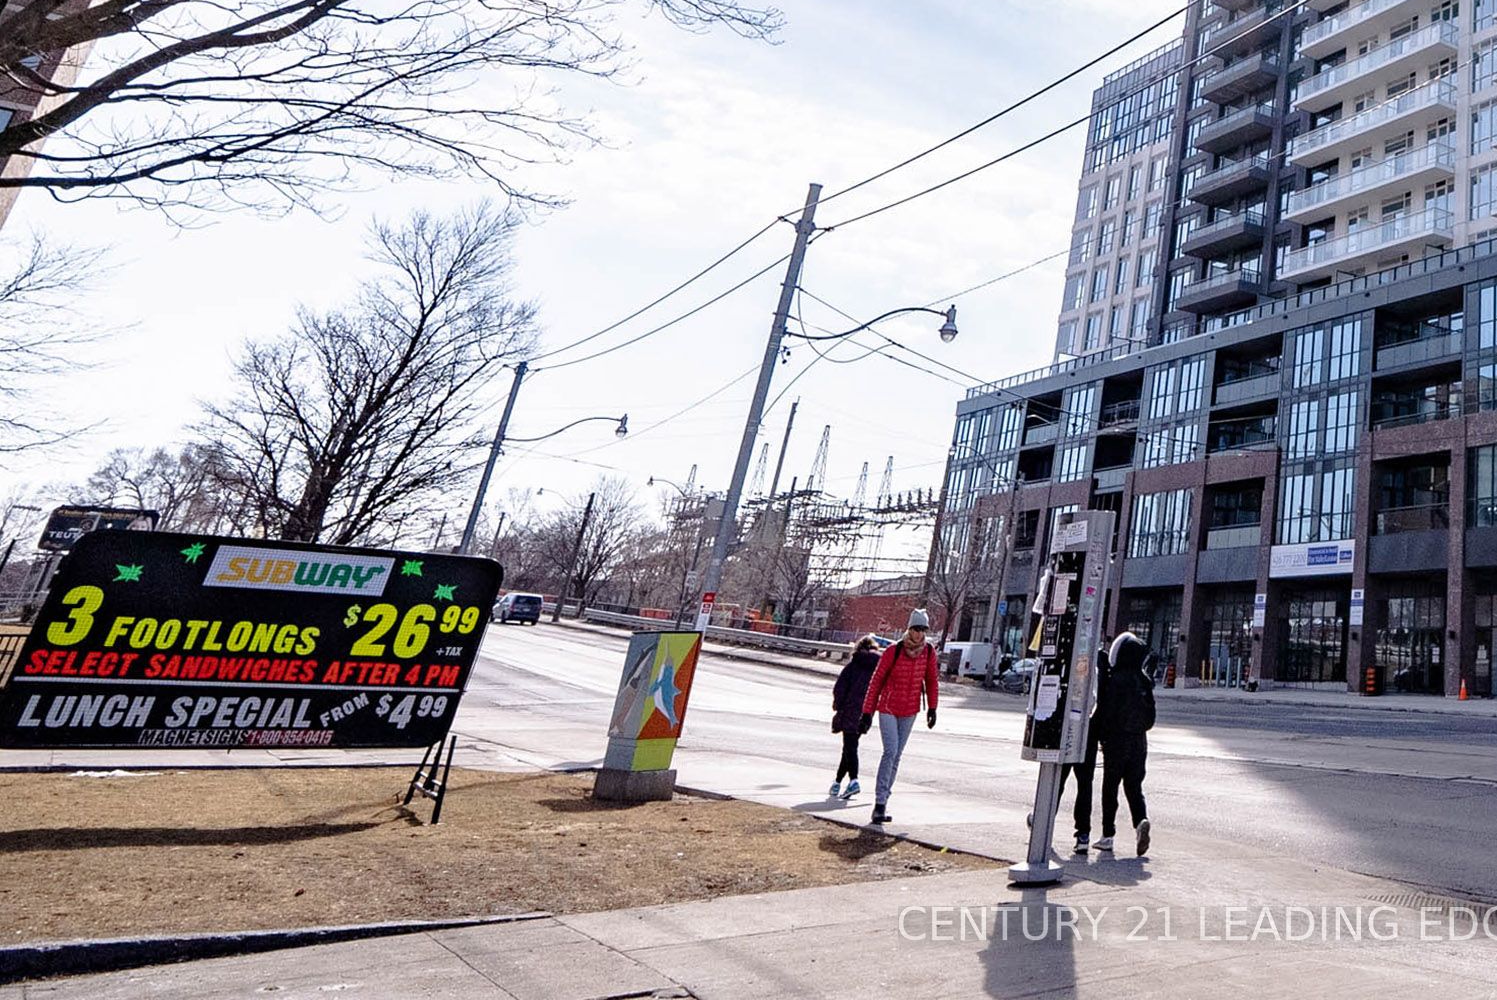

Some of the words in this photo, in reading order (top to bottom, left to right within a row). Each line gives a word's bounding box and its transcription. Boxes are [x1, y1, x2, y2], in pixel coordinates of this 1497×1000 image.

[216, 557, 386, 589] SUBWAY
[46, 585, 105, 646] 3
[103, 616, 321, 656] FOOTLONGS
[24, 649, 139, 677] SELECT
[144, 653, 318, 683] SANDWICHES
[322, 660, 401, 685] AFTER
[403, 664, 419, 685] 4
[423, 665, 461, 686] PM
[17, 694, 156, 728] LUNCH
[164, 696, 312, 729] SPECIAL
[320, 693, 370, 727] FROM
[138, 729, 250, 746] MAGNETSIGNS
